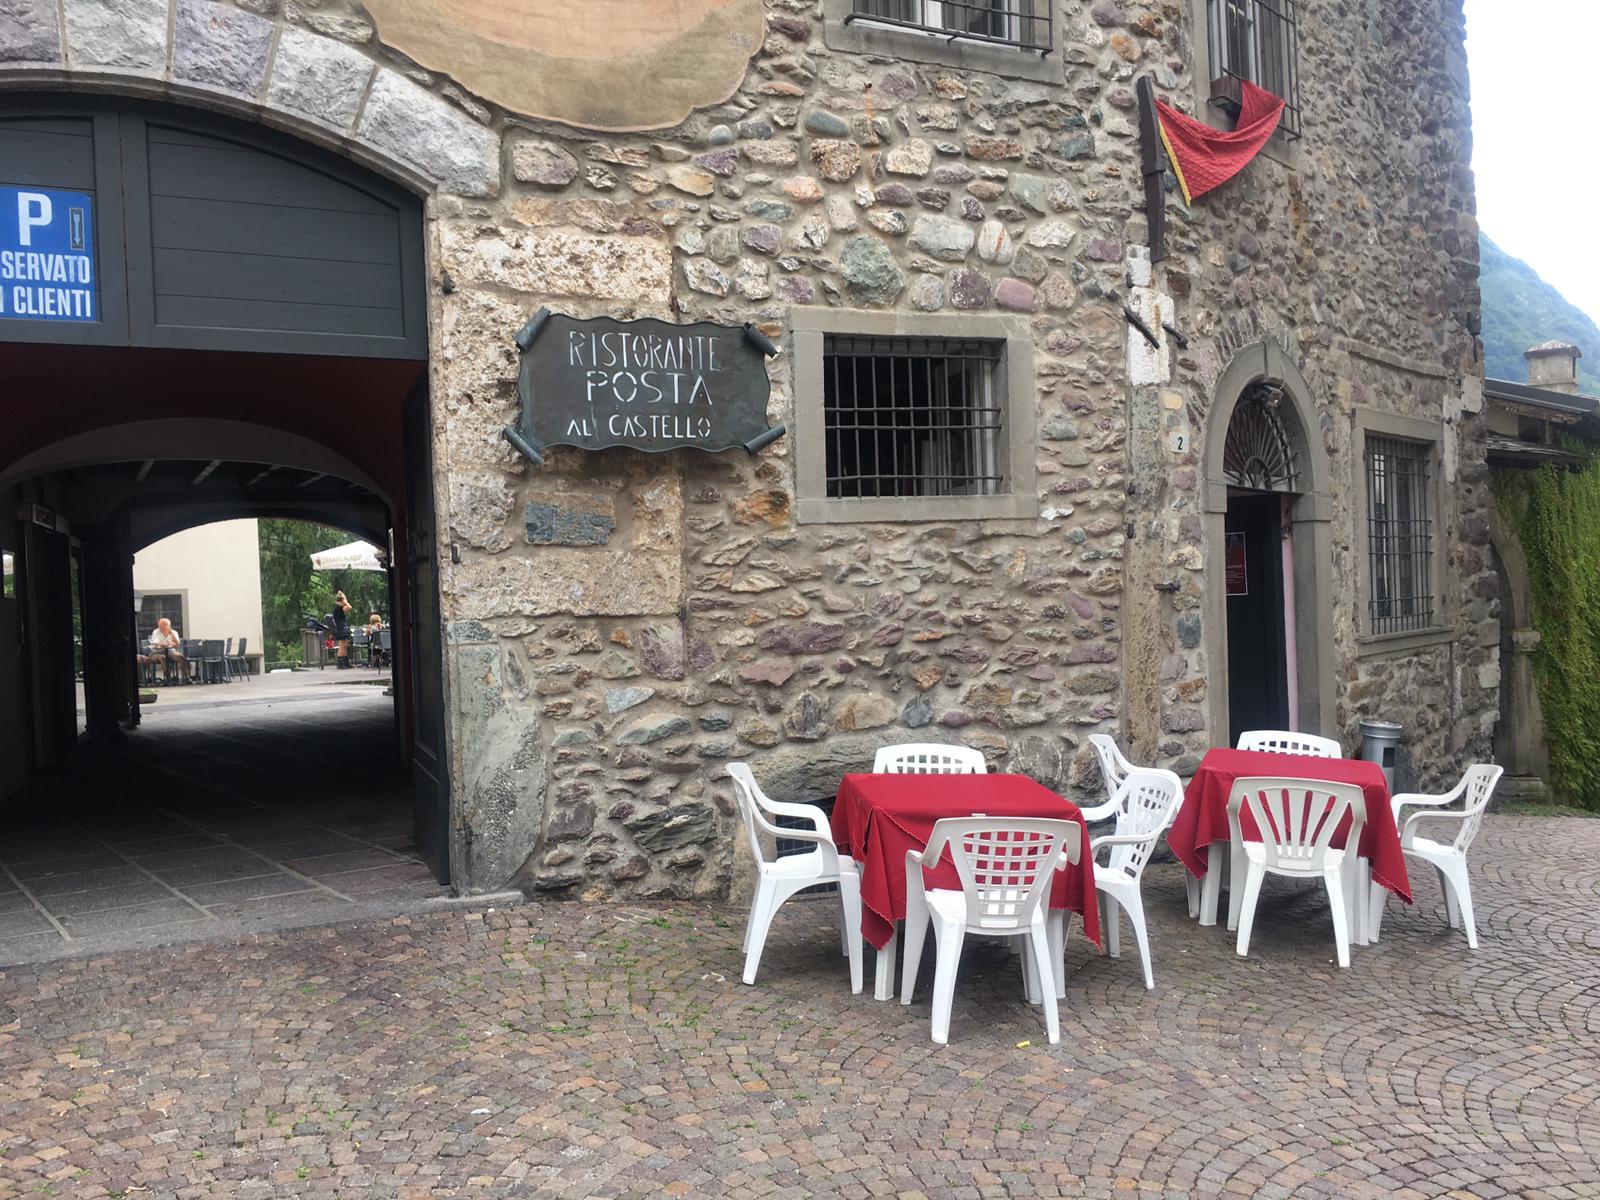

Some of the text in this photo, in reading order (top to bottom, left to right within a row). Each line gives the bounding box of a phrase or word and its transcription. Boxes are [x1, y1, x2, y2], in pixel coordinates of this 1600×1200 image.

[18, 191, 52, 246] P
[1, 250, 90, 284] SERVATO
[13, 285, 91, 317] CLIENTI
[569, 331, 721, 371] RISTORANTE
[587, 371, 712, 405] POSTA
[567, 414, 711, 438] AL CASTELLO
[1177, 436, 1183, 450] 2
